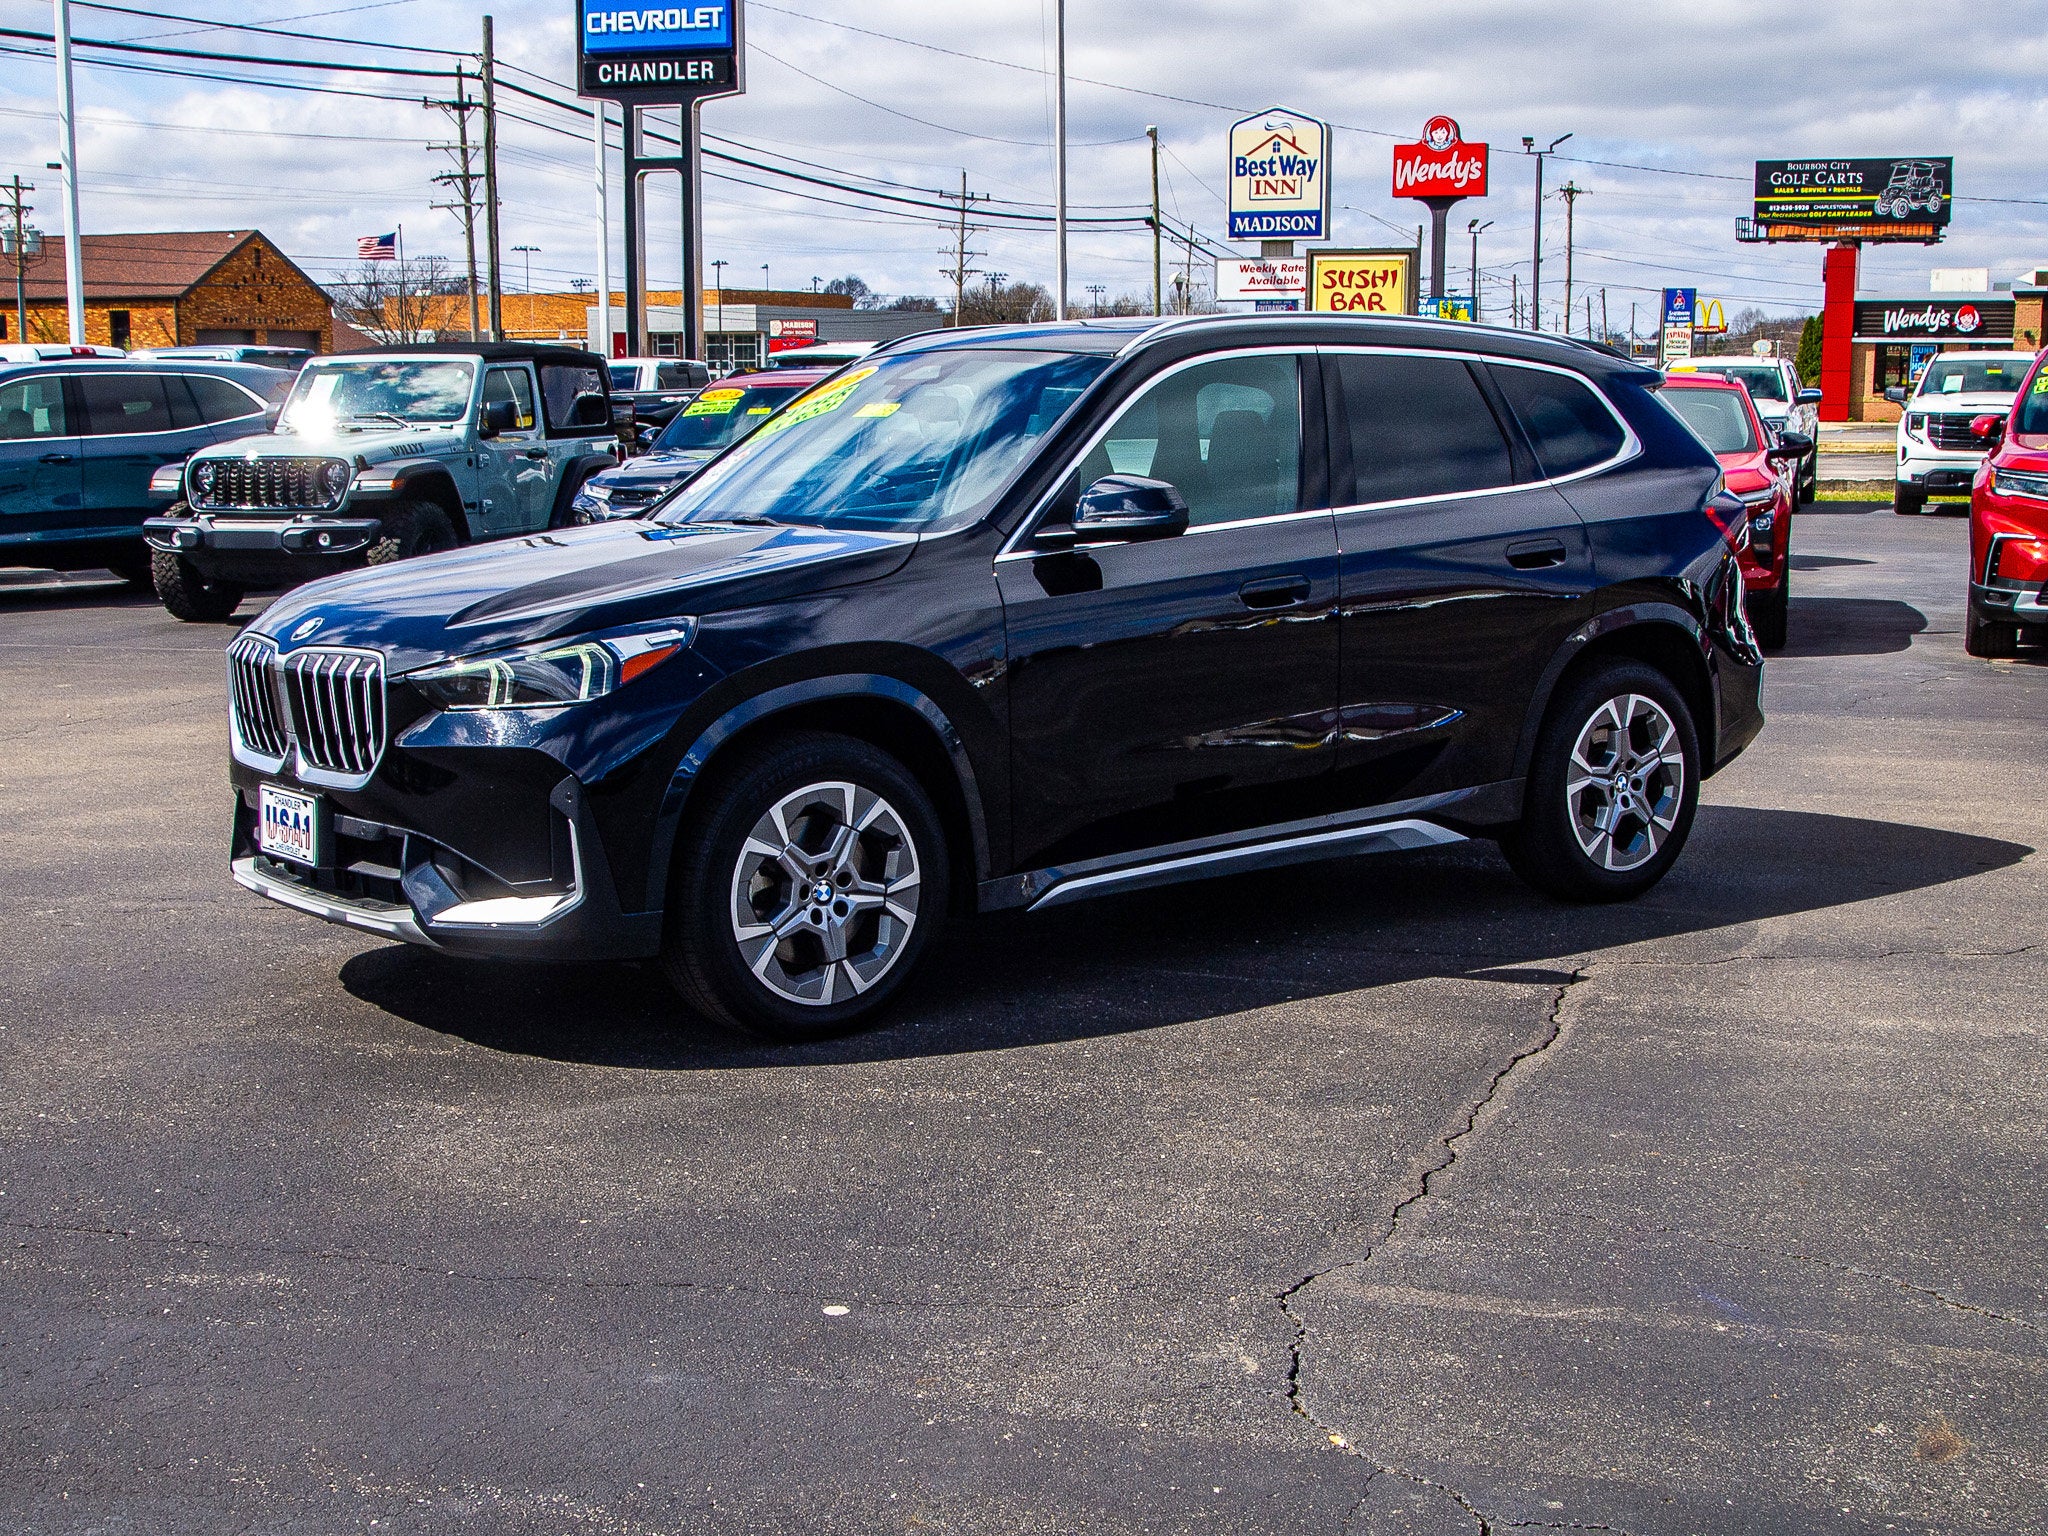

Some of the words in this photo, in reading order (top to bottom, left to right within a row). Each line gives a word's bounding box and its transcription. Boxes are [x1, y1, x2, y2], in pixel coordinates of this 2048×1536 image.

[586, 7, 723, 34] CHEVROLET
[598, 61, 714, 83] CHANDLER
[1235, 155, 1277, 178] Best
[1278, 154, 1318, 183] Way
[1395, 151, 1483, 190] Wendy's
[1787, 162, 1828, 171] BOURBON
[1830, 161, 1851, 170] CITY
[1770, 171, 1810, 185] GOLF
[1814, 171, 1864, 184] CARTS
[1254, 179, 1297, 195] INN
[1234, 215, 1317, 232] MADISON
[1239, 263, 1278, 275] Weekly
[1248, 275, 1300, 285] Available
[1322, 268, 1399, 290] SUSHI
[1330, 291, 1388, 312] BAR
[1884, 304, 1951, 333] Wendy's
[1912, 346, 1935, 354] DUNK
[1912, 354, 1920, 362] IT
[388, 442, 425, 457] WILLYS
[274, 795, 302, 811] CHANDLER
[275, 842, 301, 855] CHEVROLET
